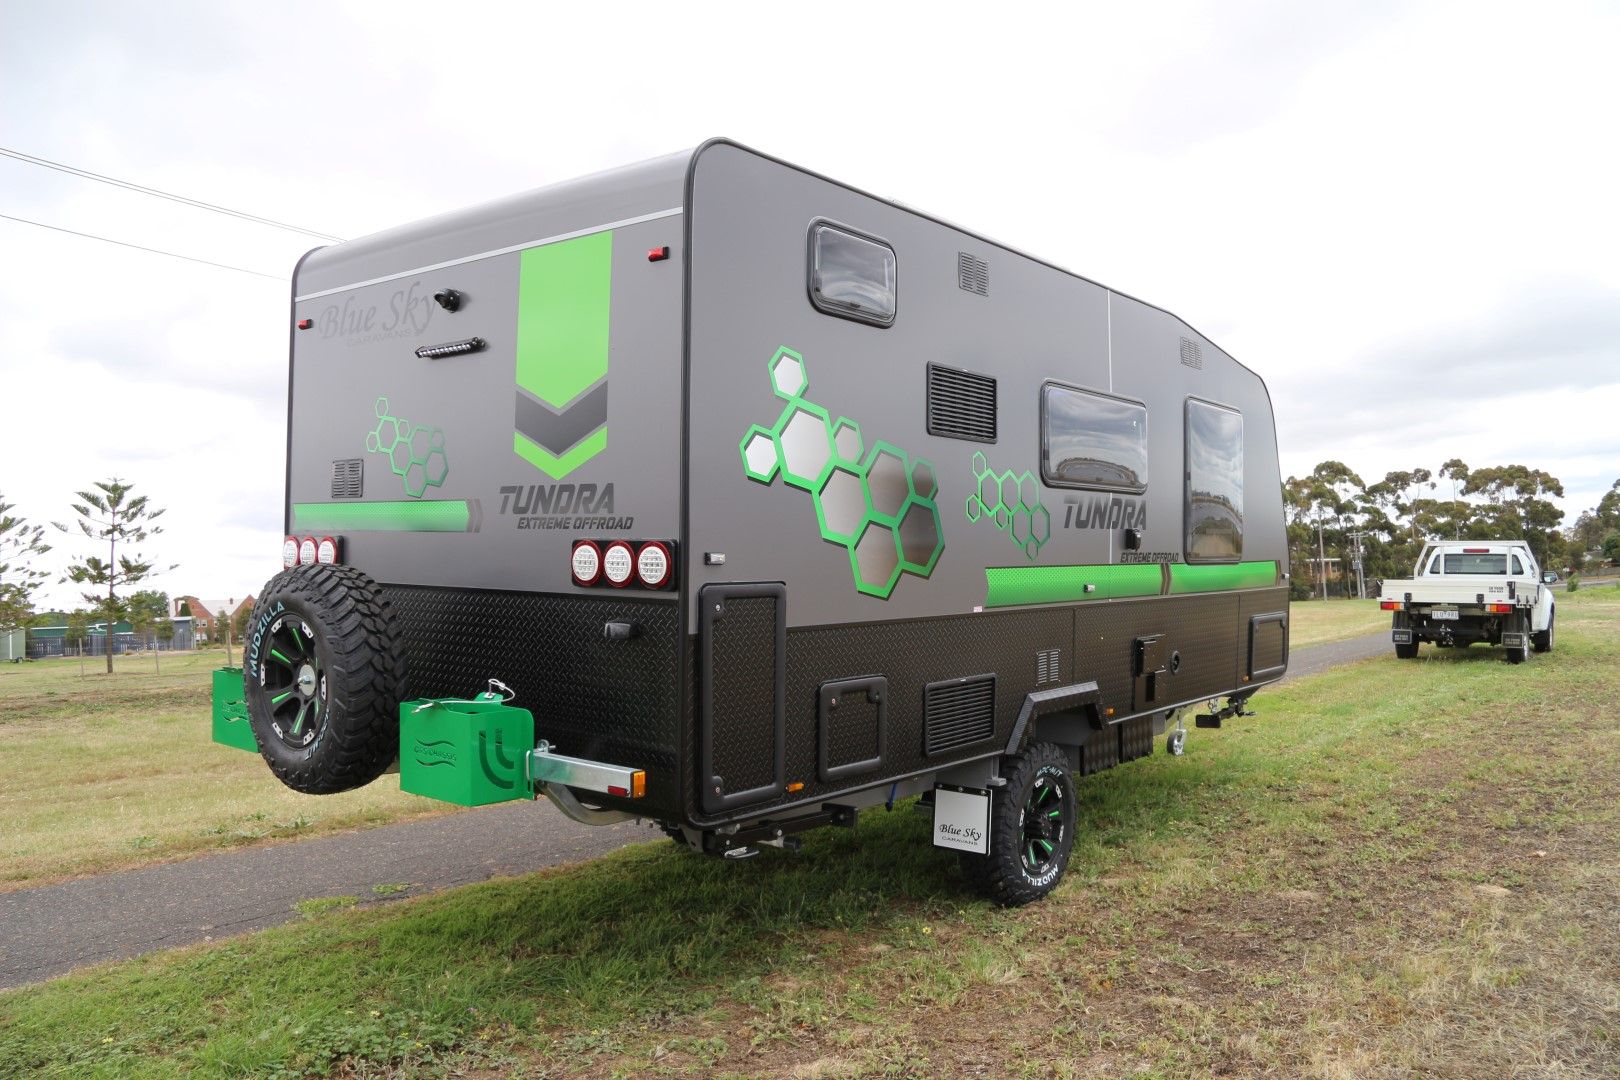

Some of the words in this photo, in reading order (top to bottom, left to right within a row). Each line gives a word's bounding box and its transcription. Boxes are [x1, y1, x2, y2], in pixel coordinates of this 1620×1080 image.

[318, 296, 377, 339] Blue
[382, 281, 436, 335] Sky
[499, 483, 614, 515] TUNDRA
[517, 516, 571, 530] EXTREME
[573, 516, 634, 530] OFFROAD
[1063, 496, 1147, 530] TUNDRA
[1120, 552, 1151, 563] EXTREME
[1152, 552, 1179, 563] OFFROAD
[249, 601, 286, 678] MUDZILLA
[940, 824, 962, 836] Blue
[962, 827, 982, 841] Sky
[1021, 864, 1059, 887] MUDZILLA
